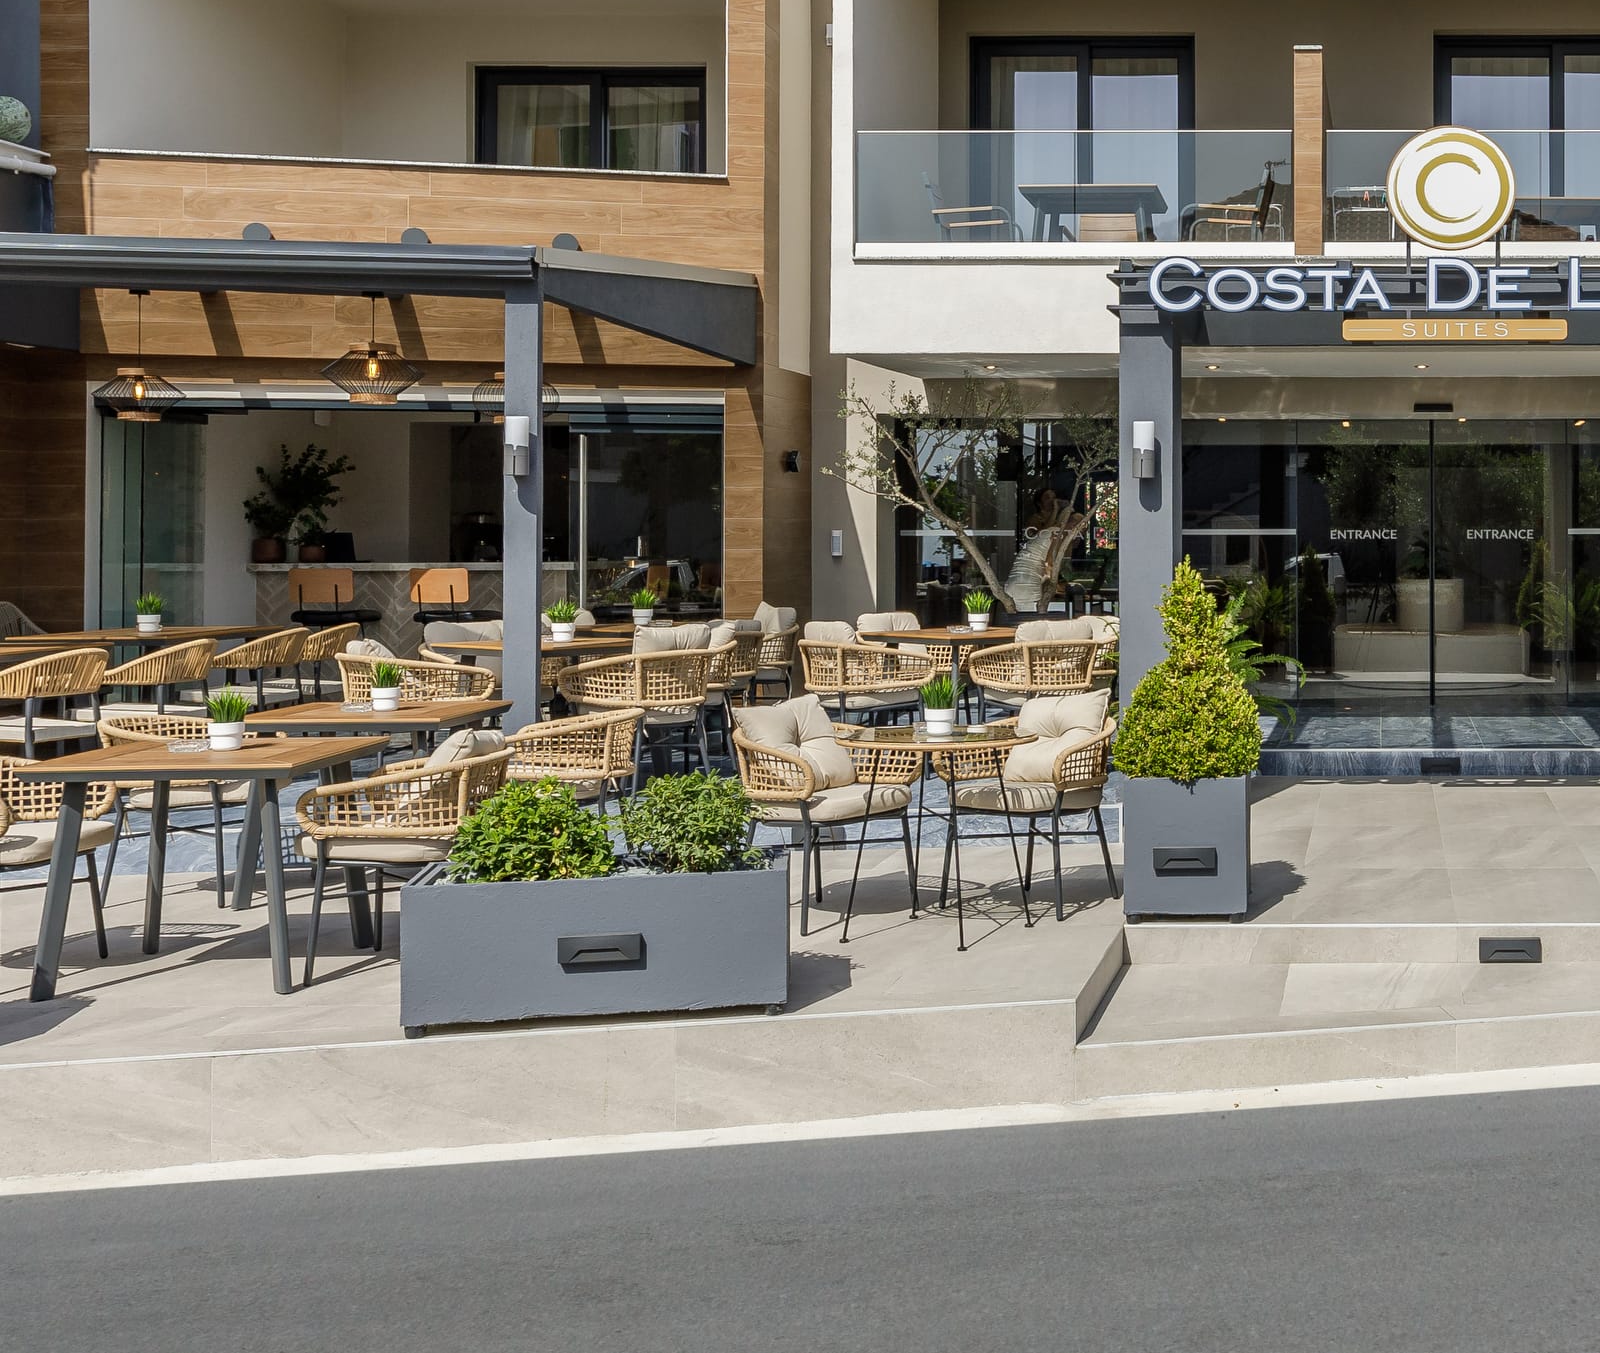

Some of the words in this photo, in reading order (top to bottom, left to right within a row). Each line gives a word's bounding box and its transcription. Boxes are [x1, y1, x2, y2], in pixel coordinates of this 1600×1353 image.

[1147, 255, 1392, 313] COSTA
[1425, 256, 1533, 312] DE
[1401, 322, 1510, 339] SUITES
[1329, 528, 1398, 540] ENTRANCE
[1466, 528, 1534, 540] ENTRANCE
